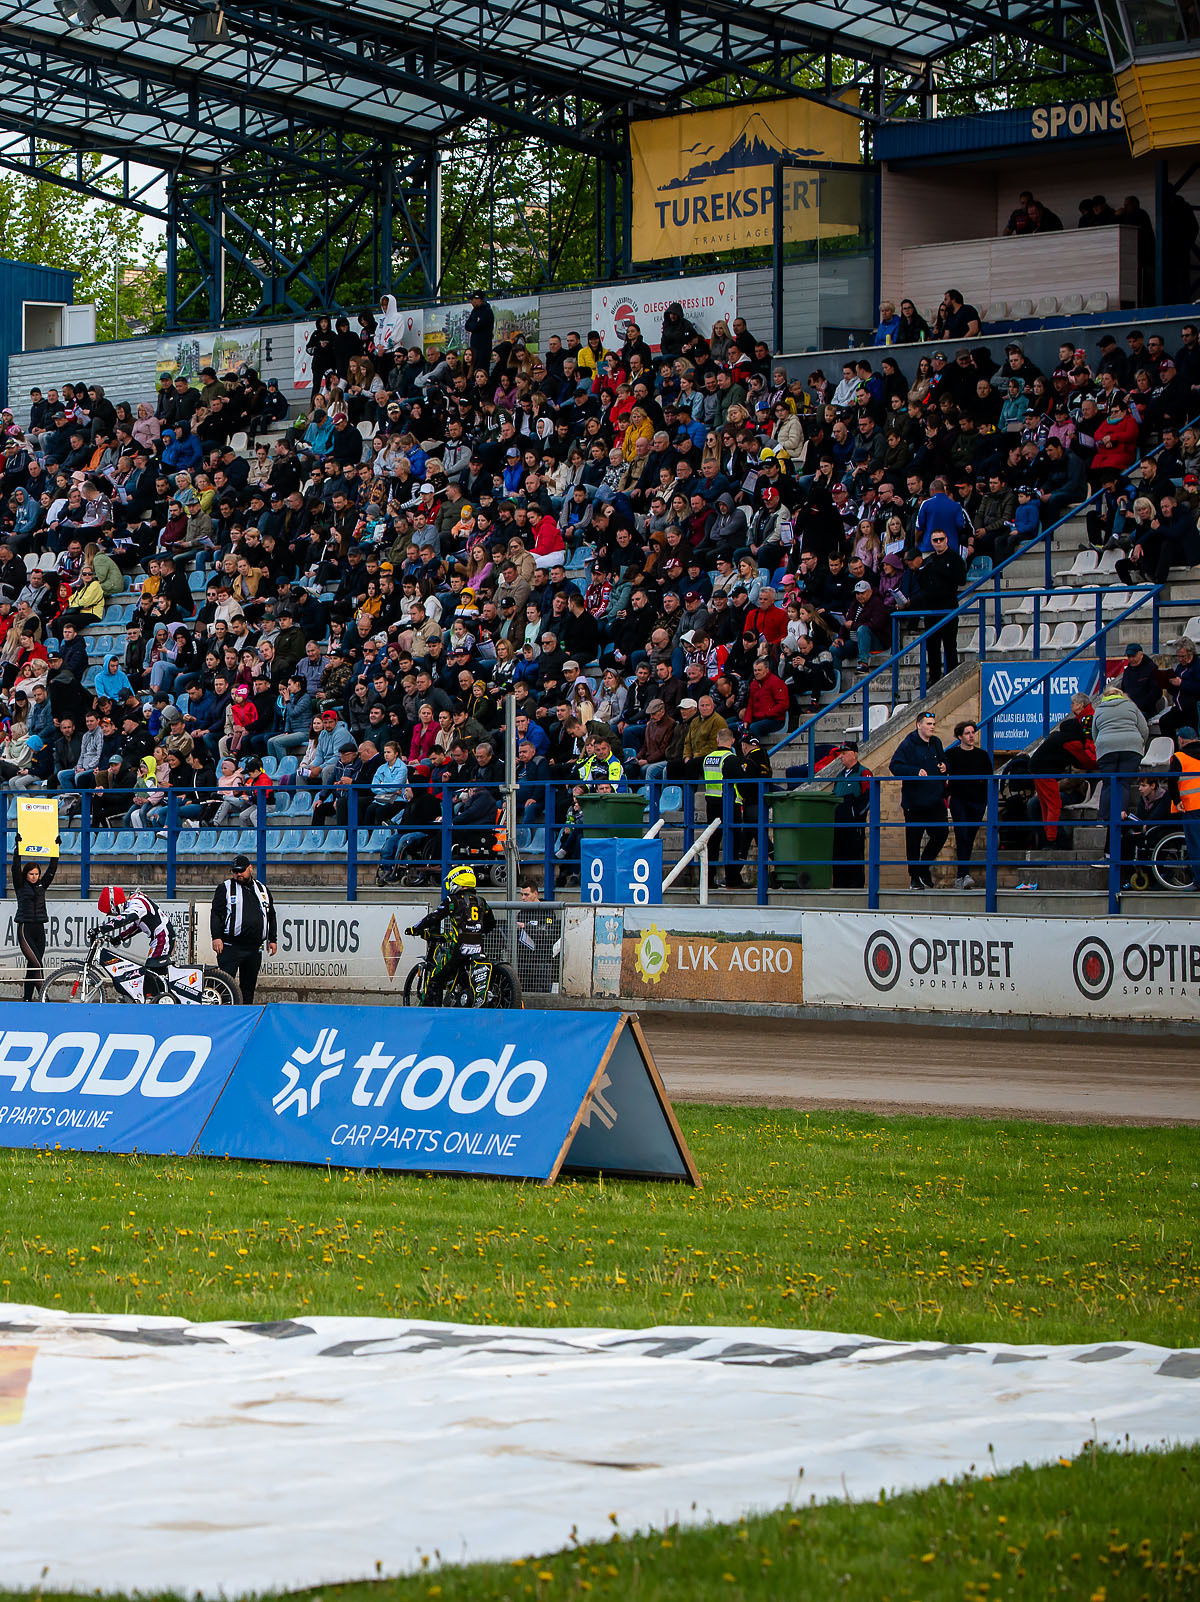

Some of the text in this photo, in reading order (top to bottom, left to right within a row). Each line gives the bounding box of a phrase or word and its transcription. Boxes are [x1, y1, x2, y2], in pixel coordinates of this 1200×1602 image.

[694, 233, 737, 246] TRAVEL
[701, 296, 715, 307] LTD
[471, 906, 479, 921] 6
[282, 919, 360, 953] STUDIOS
[677, 945, 793, 974] LVK AGRO
[909, 937, 1014, 978] OPTIBET
[909, 978, 1016, 992] SPORTA BĀRS
[1123, 985, 1187, 997] SPORTA
[351, 1041, 548, 1117] trodo
[6, 1106, 56, 1126] PARTS
[55, 1108, 114, 1128] ONLINE
[330, 1124, 522, 1157] CAR PARTS ONLINE
